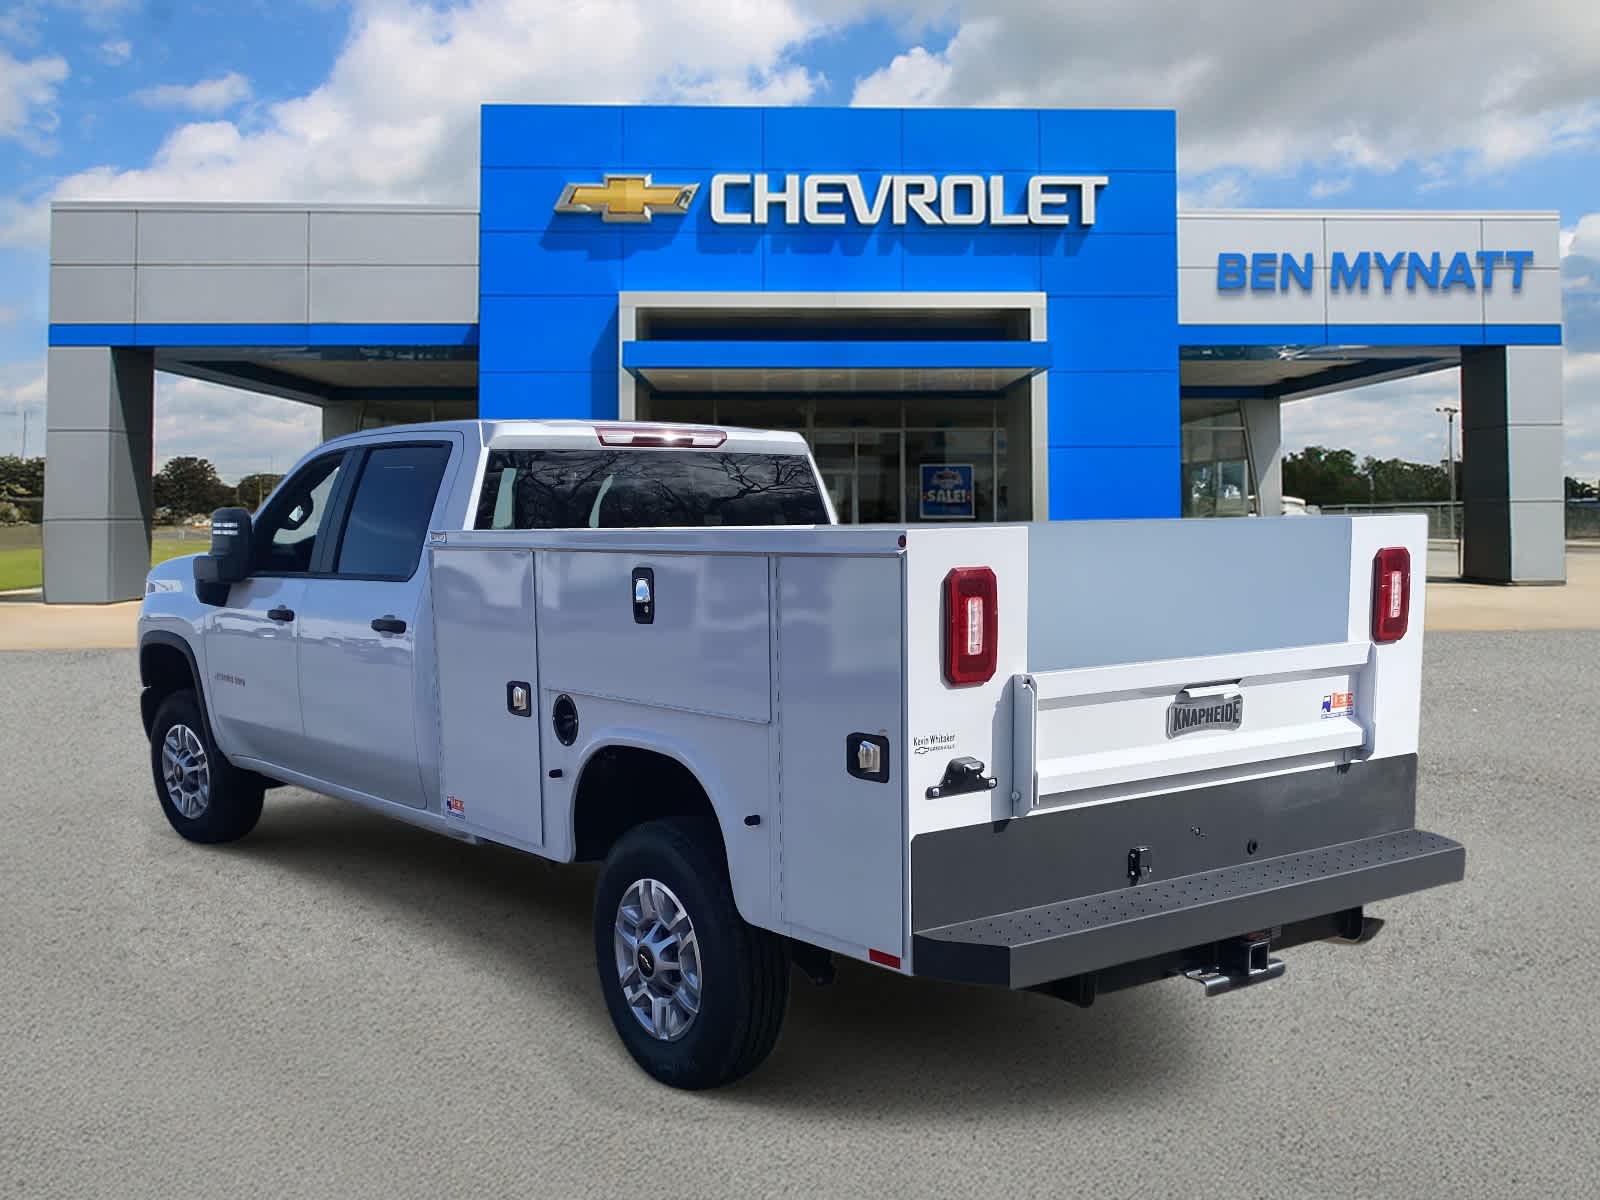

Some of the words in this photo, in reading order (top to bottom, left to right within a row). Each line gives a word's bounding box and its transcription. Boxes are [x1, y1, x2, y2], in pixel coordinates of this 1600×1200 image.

[710, 174, 1110, 225] CHEVROLET
[1217, 252, 1314, 290] BEN
[1330, 251, 1534, 290] MYNATT
[927, 489, 966, 503] SALE!
[1173, 700, 1241, 731] KNAPHEIDE
[913, 736, 929, 746] Kevin
[929, 734, 955, 745] Whitaker
